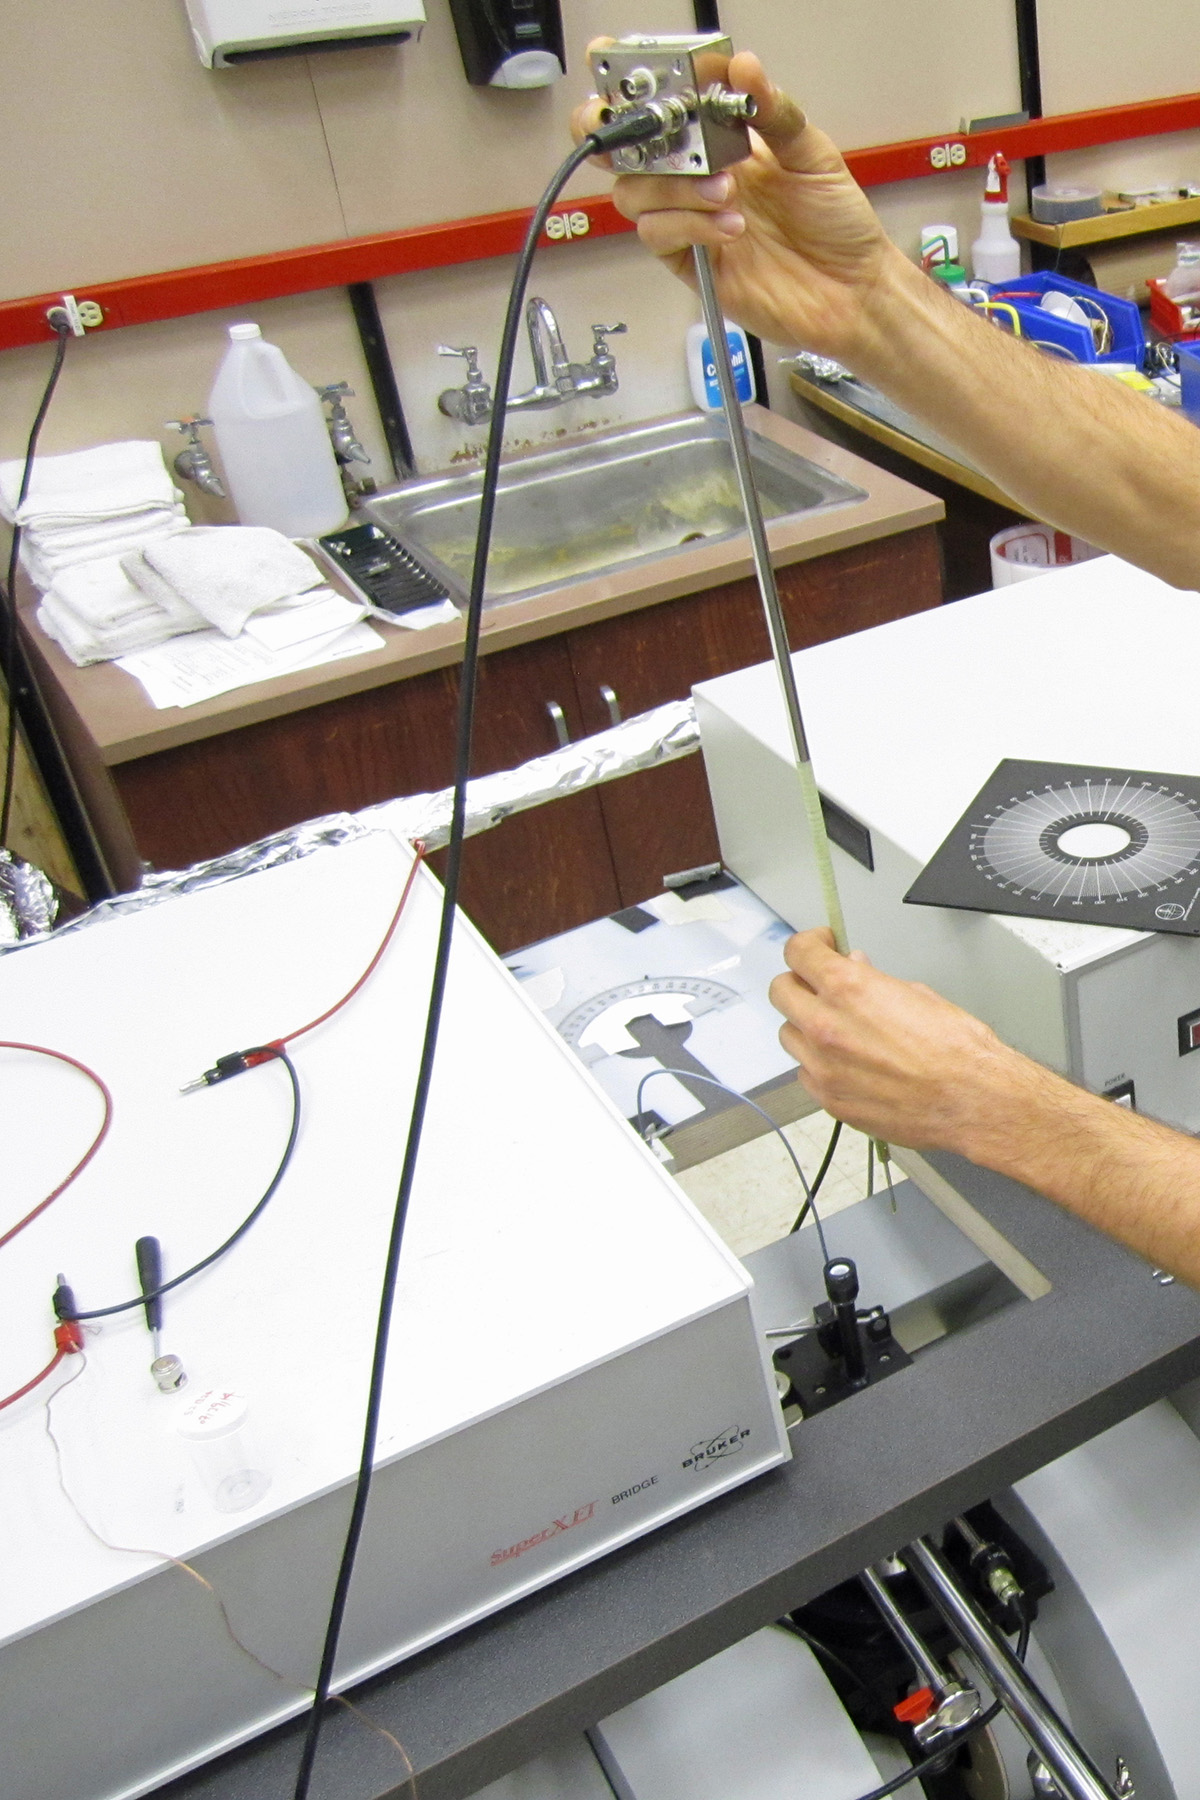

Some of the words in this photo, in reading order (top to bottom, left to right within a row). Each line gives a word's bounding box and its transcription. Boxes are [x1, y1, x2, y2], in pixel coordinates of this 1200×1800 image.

[1104, 1072, 1126, 1087] POWER
[682, 1429, 751, 1469] BRUKER
[610, 1474, 660, 1505] BRIDGE
